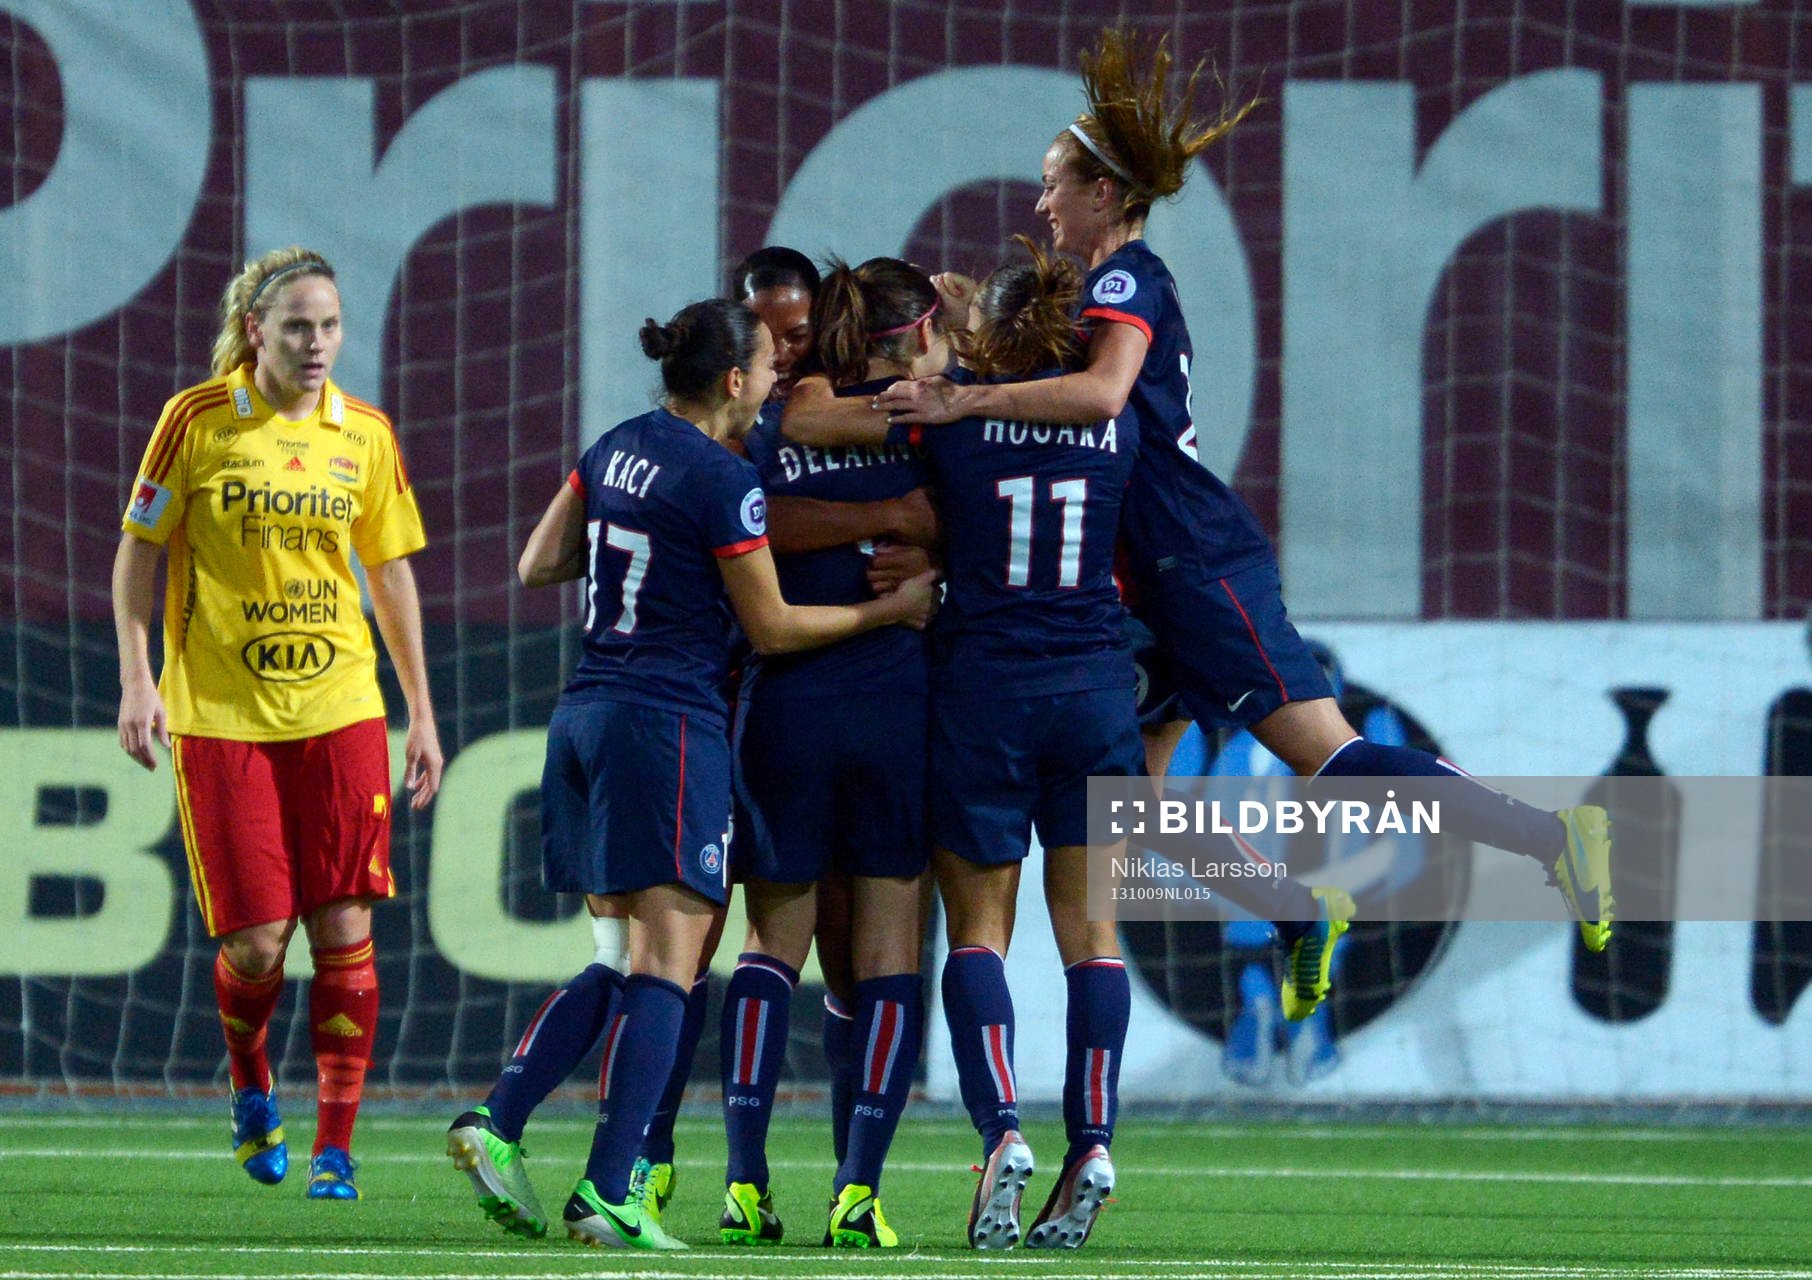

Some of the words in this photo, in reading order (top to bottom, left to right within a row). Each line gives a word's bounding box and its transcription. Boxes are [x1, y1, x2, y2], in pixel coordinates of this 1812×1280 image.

[602, 450, 662, 499] KACI
[222, 481, 353, 523] Prioritet
[241, 515, 340, 553] Finans
[996, 475, 1086, 590] 11
[307, 578, 338, 600] UN
[584, 518, 652, 634] 17
[241, 600, 338, 623] WOMEN
[728, 1095, 760, 1108] PSG
[854, 1103, 885, 1119] PSG
